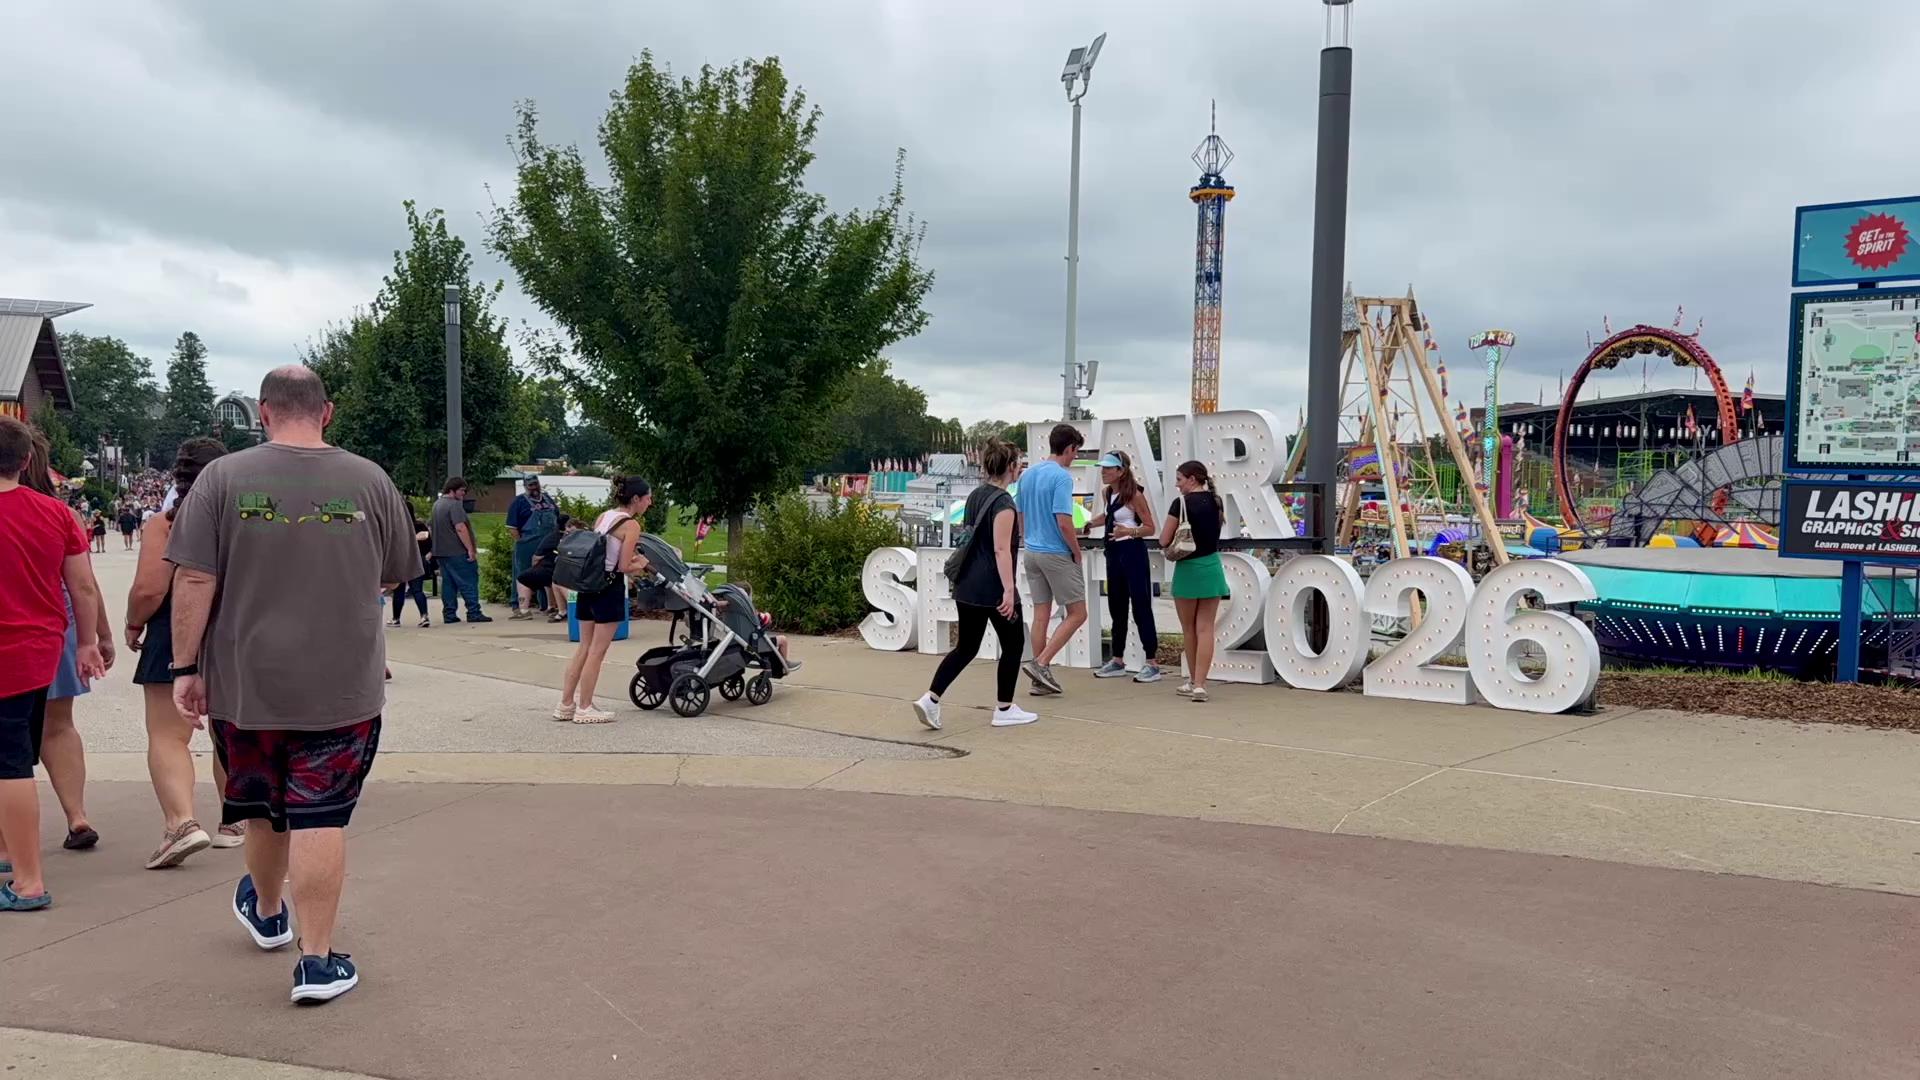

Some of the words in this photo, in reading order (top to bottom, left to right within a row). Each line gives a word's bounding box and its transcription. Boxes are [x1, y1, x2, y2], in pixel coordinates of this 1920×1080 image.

[1859, 228, 1882, 243] GET
[1857, 238, 1896, 256] SPIRIT
[1470, 332, 1486, 348] TOP
[1814, 540, 1839, 549] Learn
[1840, 543, 1864, 551] more
[1865, 542, 1875, 550] at
[1181, 552, 1600, 714] 2026
